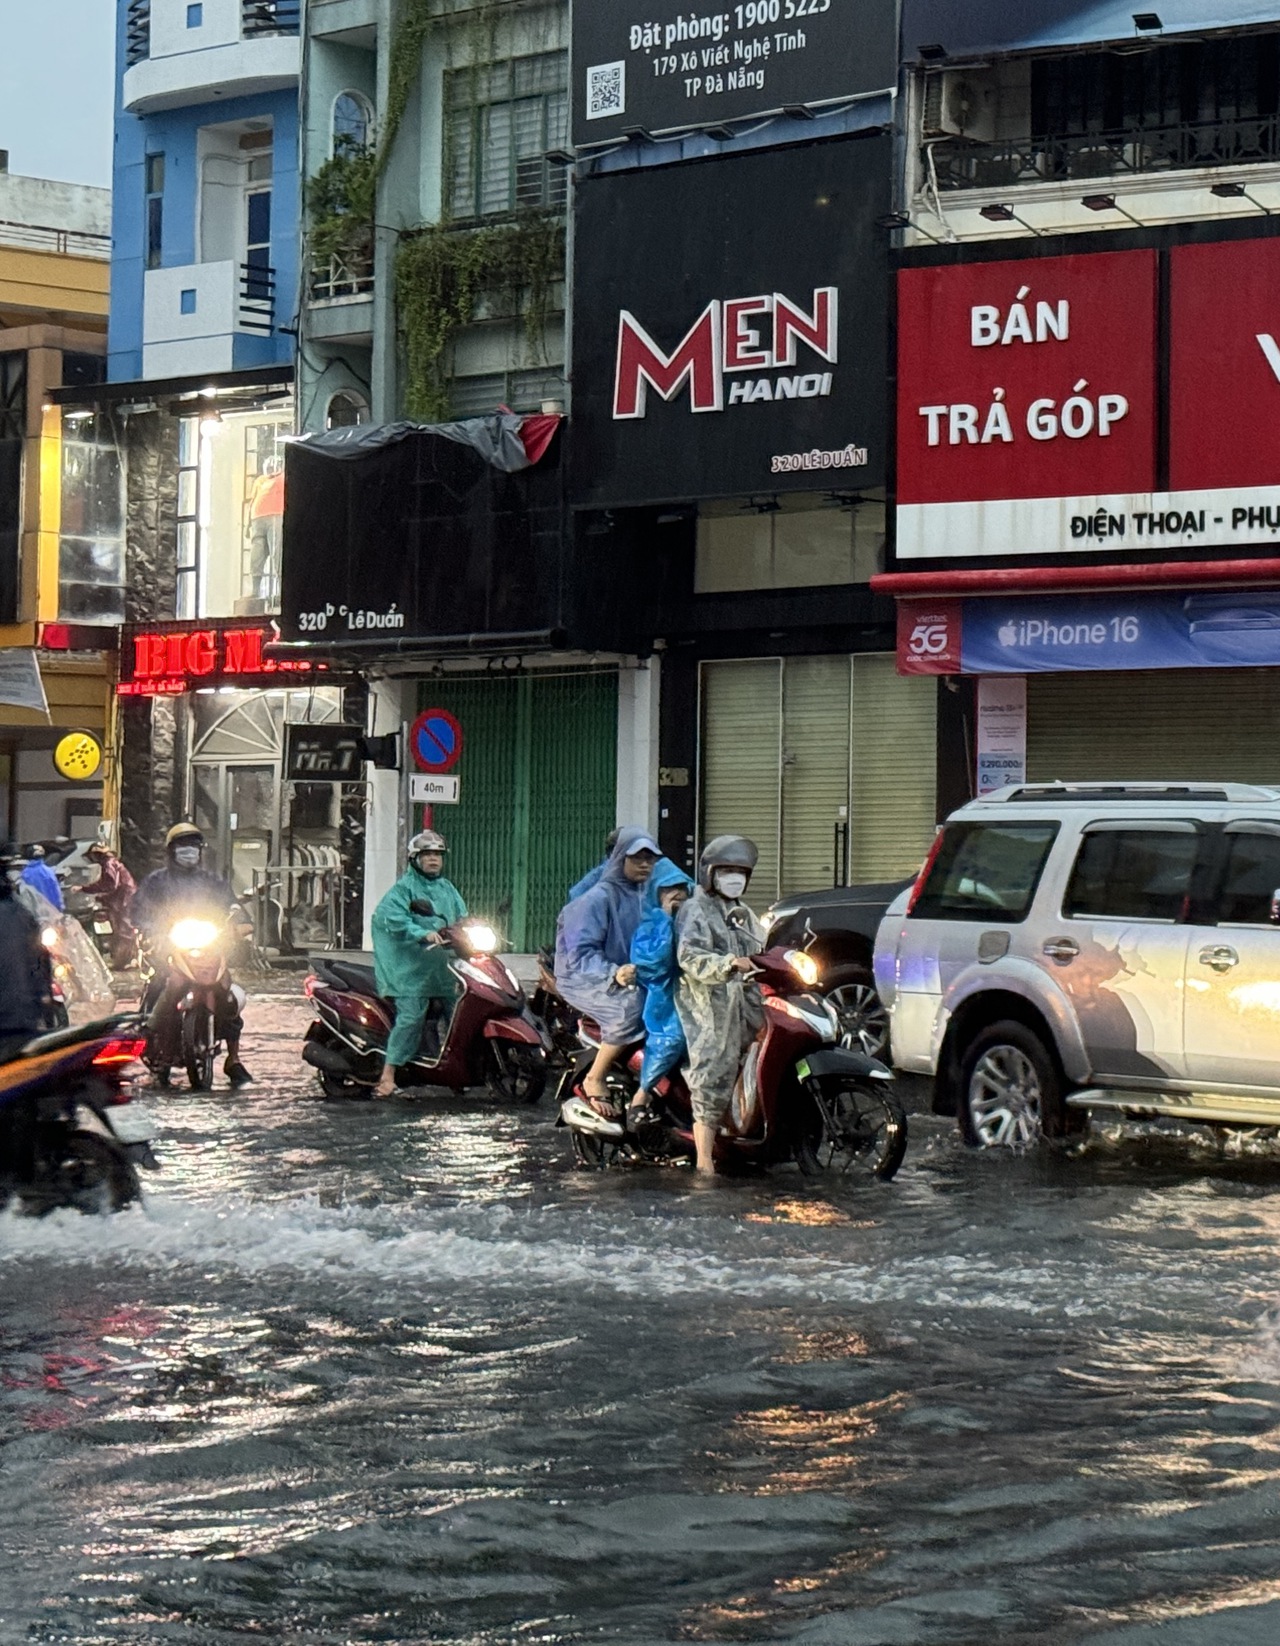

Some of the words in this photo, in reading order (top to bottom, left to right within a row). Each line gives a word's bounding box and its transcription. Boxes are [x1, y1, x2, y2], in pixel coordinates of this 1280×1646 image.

[629, 22, 661, 54] Đặt
[665, 12, 729, 49] phòng:
[734, 0, 780, 29] 1900
[652, 57, 678, 77] 179
[681, 51, 698, 72] Xô
[702, 44, 730, 68] Viết
[734, 37, 771, 65] Nghệ
[775, 29, 806, 53] Tĩnh
[684, 77, 702, 98] TP
[705, 73, 724, 95] Đà
[728, 66, 765, 91] Nẵng
[971, 285, 1071, 347] BÁN
[613, 286, 838, 420] MEN
[728, 372, 833, 405] HANOI
[919, 387, 1014, 446] TRẢ
[1027, 378, 1129, 440] GÓP
[771, 455, 801, 473] 320
[802, 449, 821, 470] LÊ
[1071, 507, 1125, 542] ĐIỆN
[1132, 510, 1205, 539] THOẠI
[348, 610, 365, 629] Lê
[366, 603, 404, 628] Duẩn
[1019, 619, 1106, 646] iPhone
[1110, 616, 1139, 643] 16
[133, 630, 218, 676] BIG
[909, 625, 948, 654] 5G
[424, 781, 444, 794] 40m
